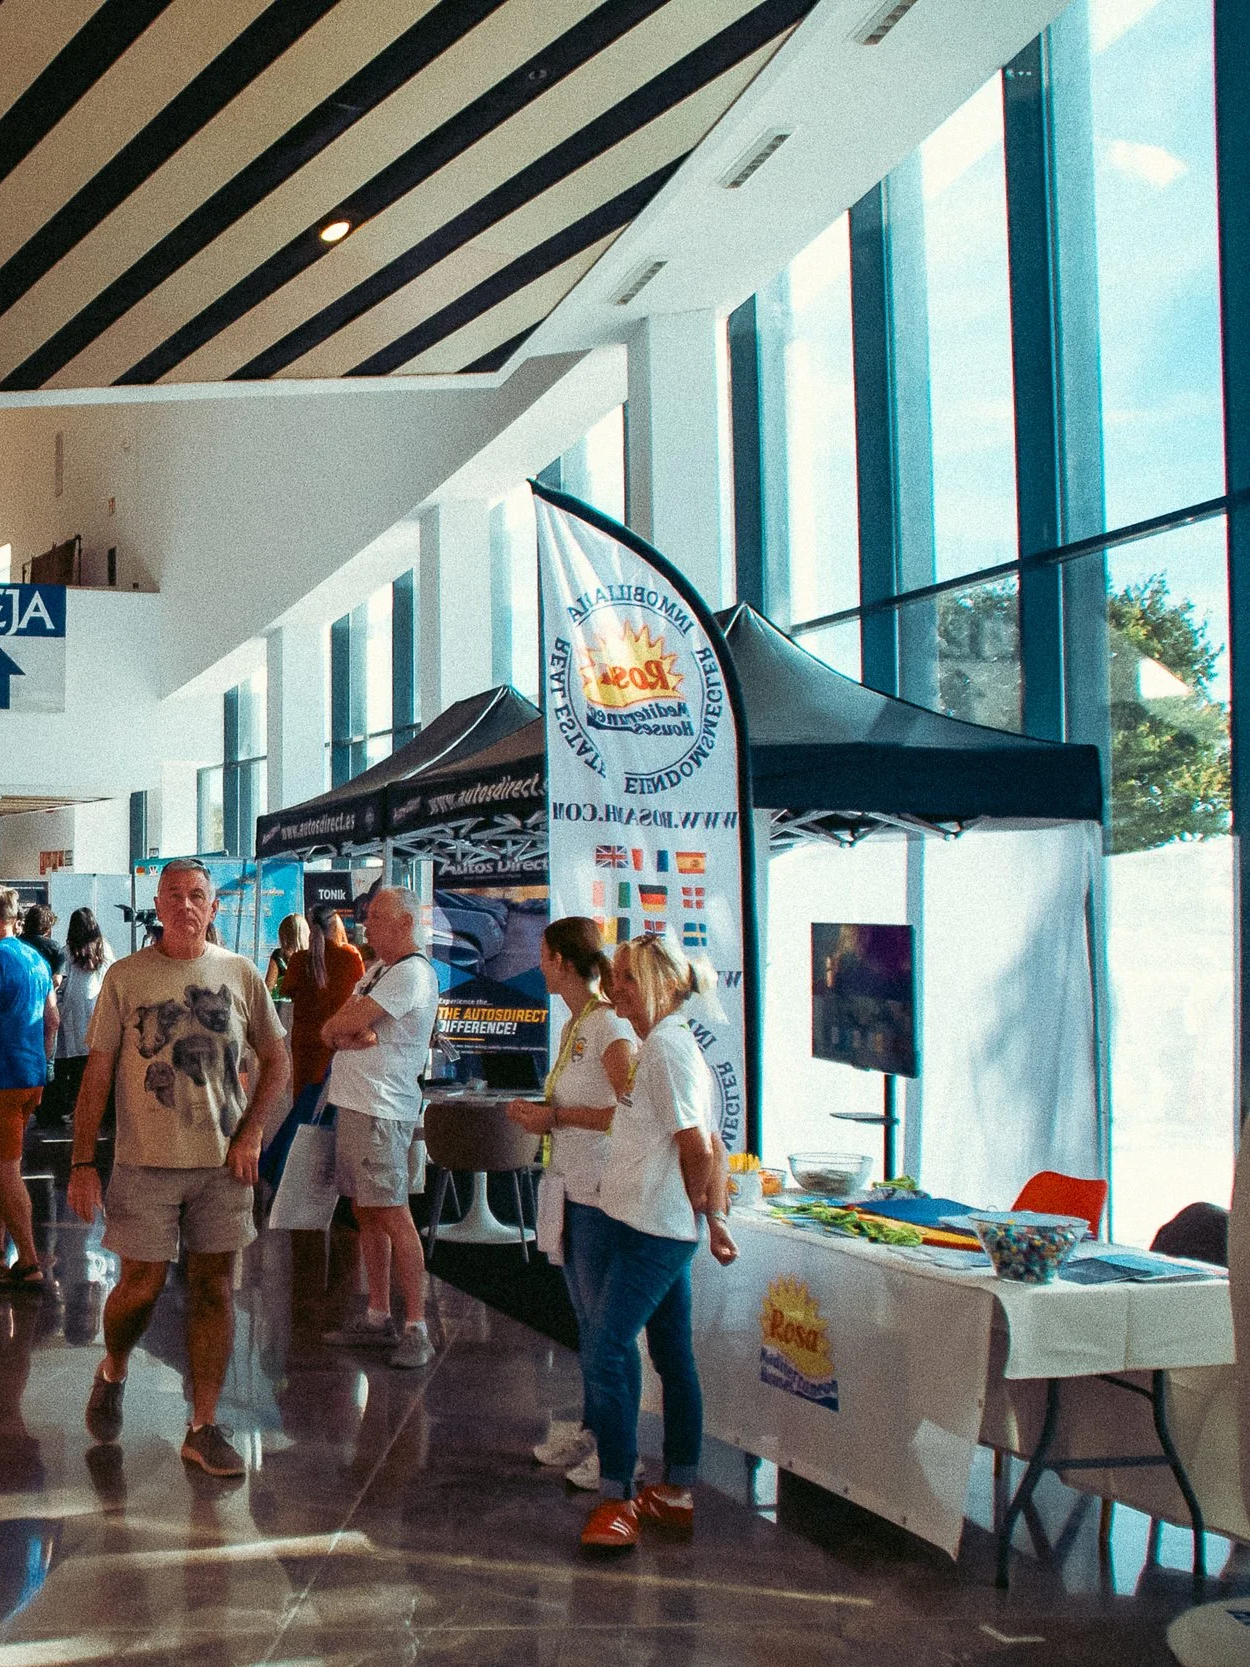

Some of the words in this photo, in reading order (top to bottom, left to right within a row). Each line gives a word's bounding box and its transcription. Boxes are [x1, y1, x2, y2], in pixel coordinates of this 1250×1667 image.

[428, 772, 547, 816] www.autosdirect.
[281, 811, 355, 841] www.autosdirect.es
[438, 858, 494, 876] Autos
[497, 855, 548, 874] Direct
[438, 1006, 461, 1020] THE
[463, 1007, 549, 1023] AUTOSDIRECT
[438, 1019, 518, 1035] DIFFERENCE!
[769, 1308, 819, 1354] Rosa
